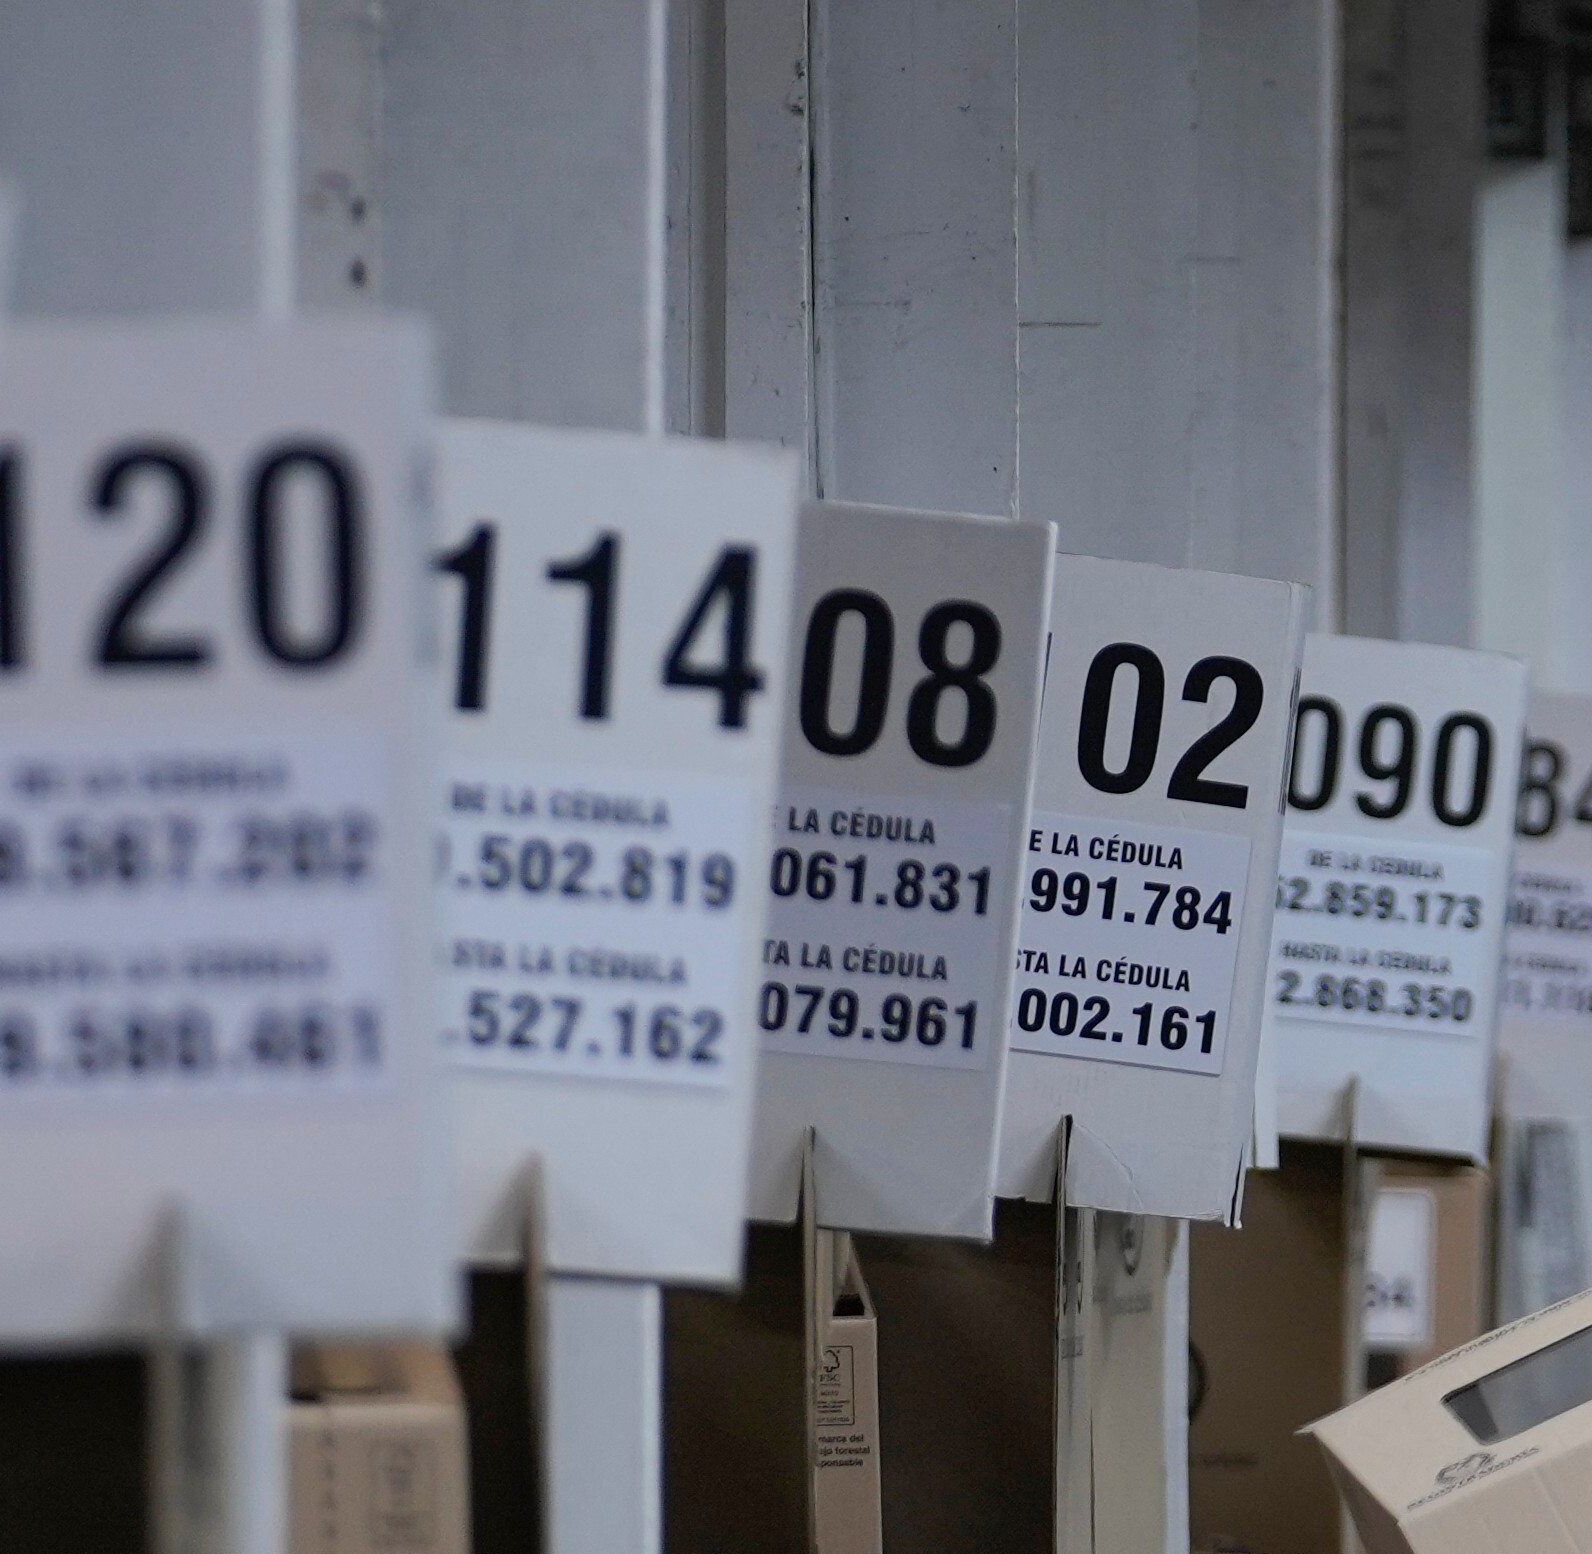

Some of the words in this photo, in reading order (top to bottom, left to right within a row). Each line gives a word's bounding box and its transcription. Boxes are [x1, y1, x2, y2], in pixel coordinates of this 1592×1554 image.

[431, 522, 765, 730] 114
[799, 587, 1003, 768] 08
[1039, 632, 1265, 809] 02
[1289, 695, 1493, 828] 090
[788, 806, 820, 833] LA
[831, 807, 936, 845] CÉDULA
[1051, 832, 1080, 857] LA
[1089, 834, 1184, 870] CÉDULA
[437, 832, 737, 908] .502.819
[769, 847, 992, 916] 061.831
[1029, 867, 1233, 935] 991.784
[801, 943, 833, 970] LA
[843, 944, 948, 981] CÉDULA
[1059, 954, 1087, 979] LA
[1096, 956, 1191, 992] CÉDULA
[758, 981, 978, 1050] 079.961
[1017, 988, 1217, 1054] 002.161
[835, 1446, 871, 1455] forestal
[849, 1434, 864, 1443] del
